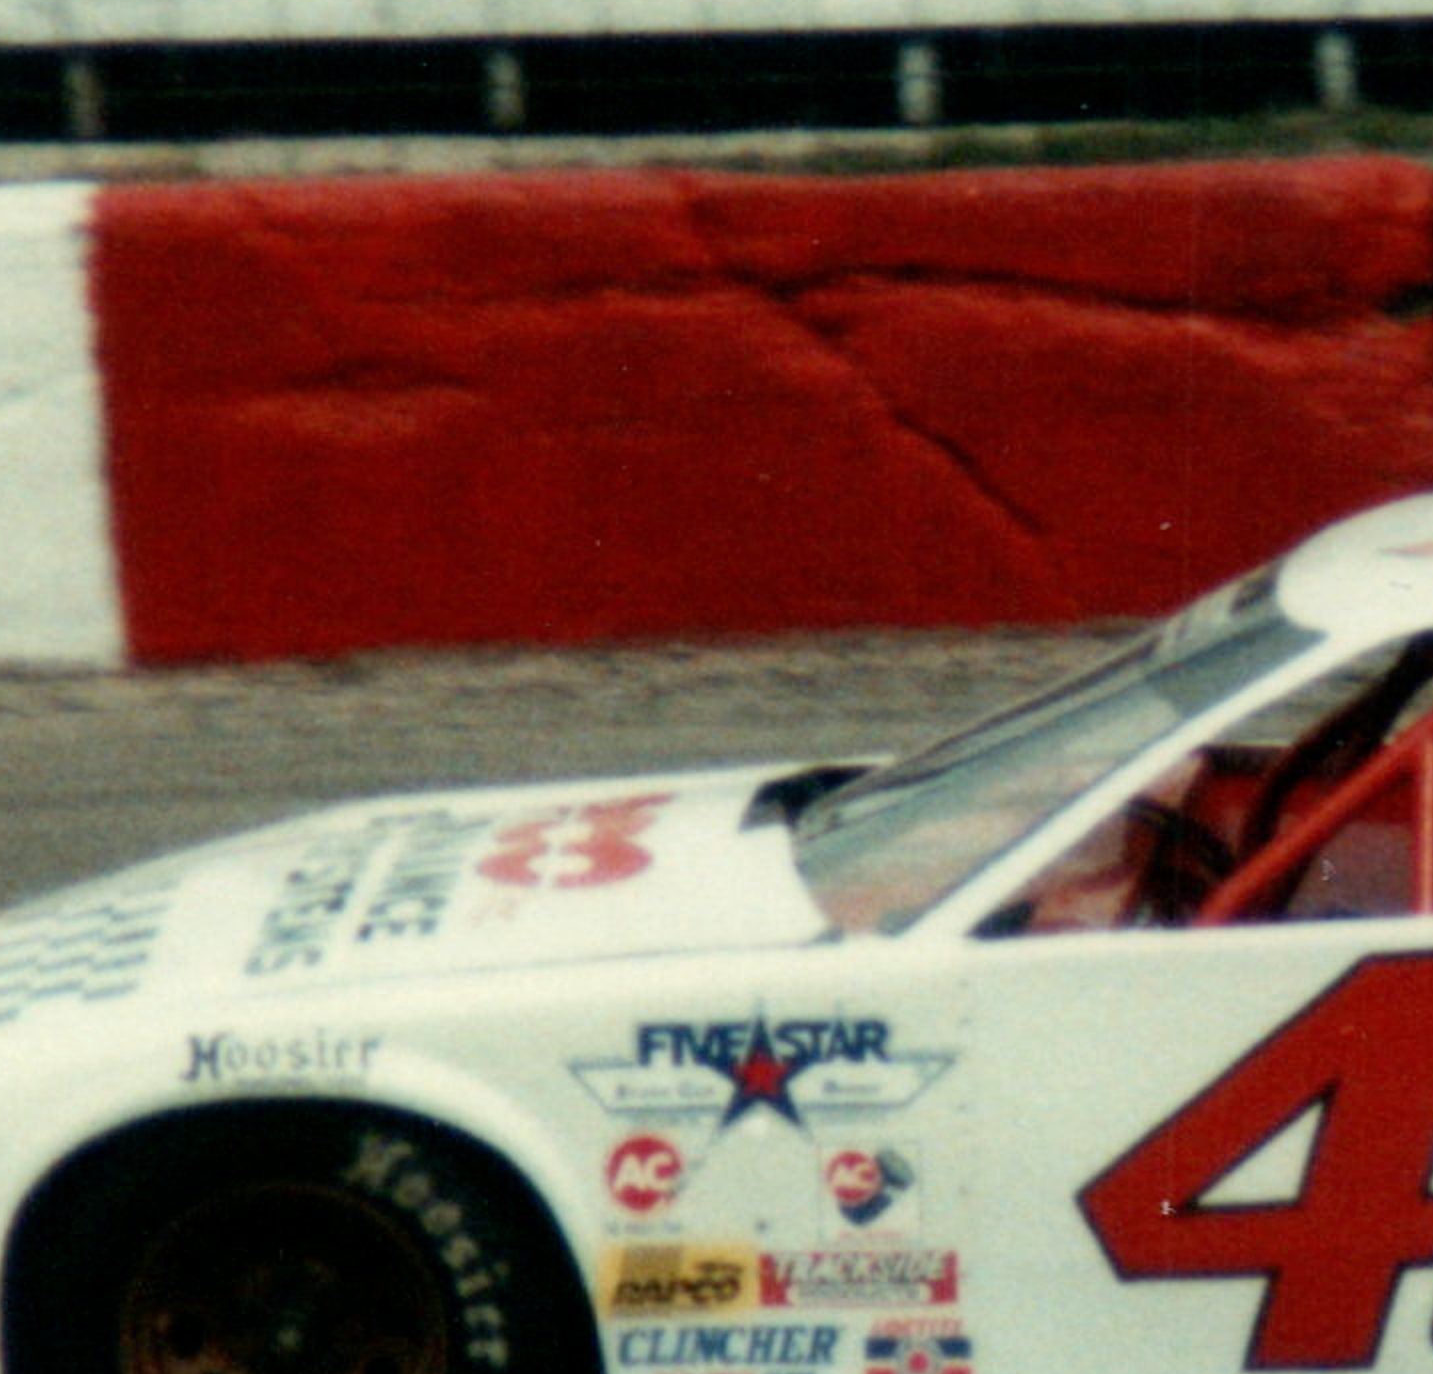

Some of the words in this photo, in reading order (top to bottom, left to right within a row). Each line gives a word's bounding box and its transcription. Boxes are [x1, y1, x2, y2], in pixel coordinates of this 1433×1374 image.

[635, 1020, 751, 1067] FIVE
[769, 1017, 892, 1064] STAR
[612, 1152, 683, 1193] AC
[828, 1164, 883, 1192] AC
[618, 1325, 843, 1366] CLINCHER
